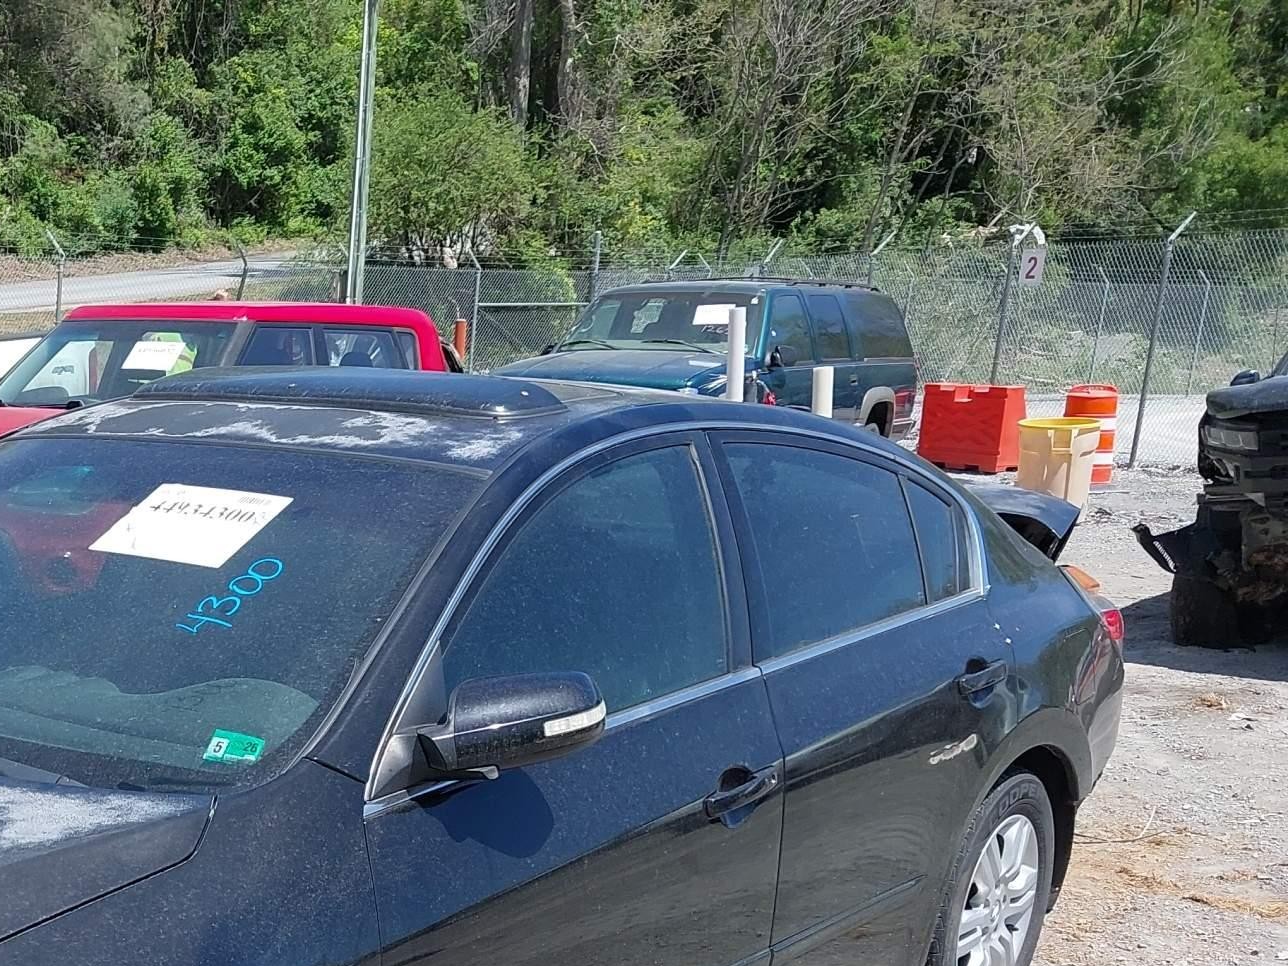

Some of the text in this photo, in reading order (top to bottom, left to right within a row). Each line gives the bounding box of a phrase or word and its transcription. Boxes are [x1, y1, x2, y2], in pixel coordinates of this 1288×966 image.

[1024, 256, 1039, 280] 2
[149, 500, 256, 523] 44934300
[175, 557, 284, 635] 4300
[212, 740, 260, 754] 5 26
